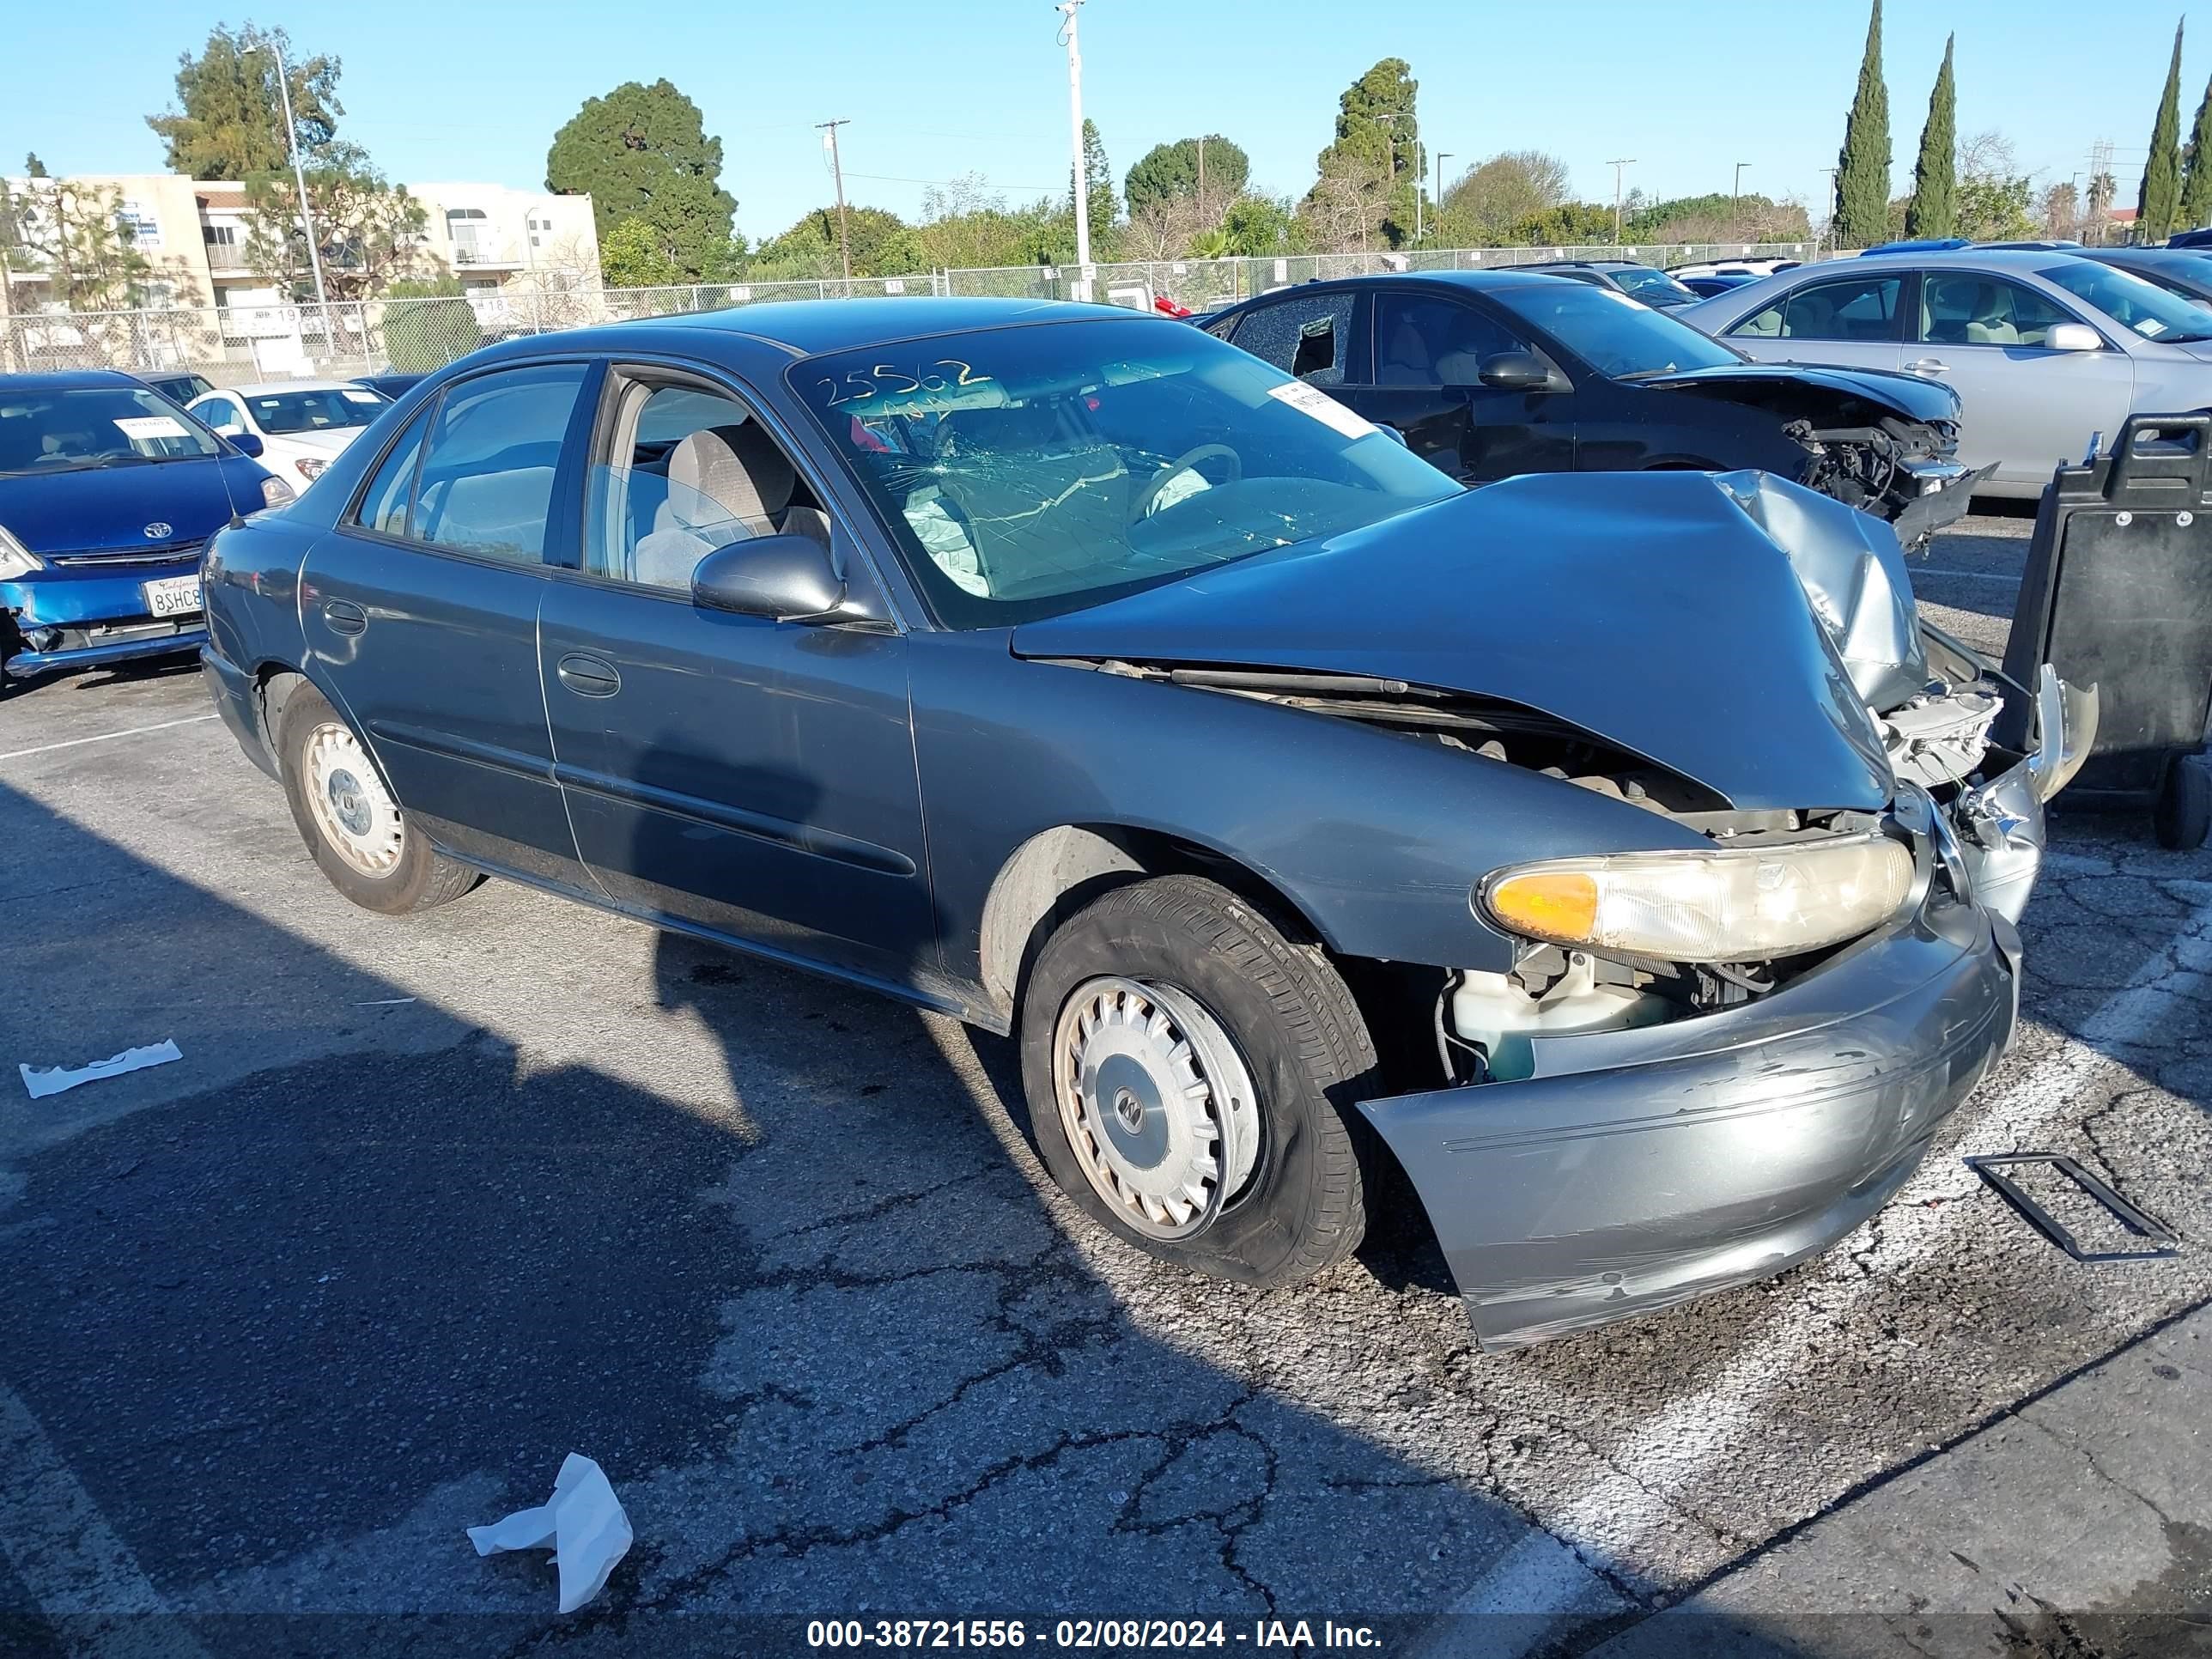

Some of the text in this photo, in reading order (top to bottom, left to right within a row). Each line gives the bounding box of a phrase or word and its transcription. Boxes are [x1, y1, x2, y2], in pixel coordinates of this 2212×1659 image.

[489, 300, 503, 311] 18
[277, 309, 295, 322] 19
[817, 360, 994, 407] 25562
